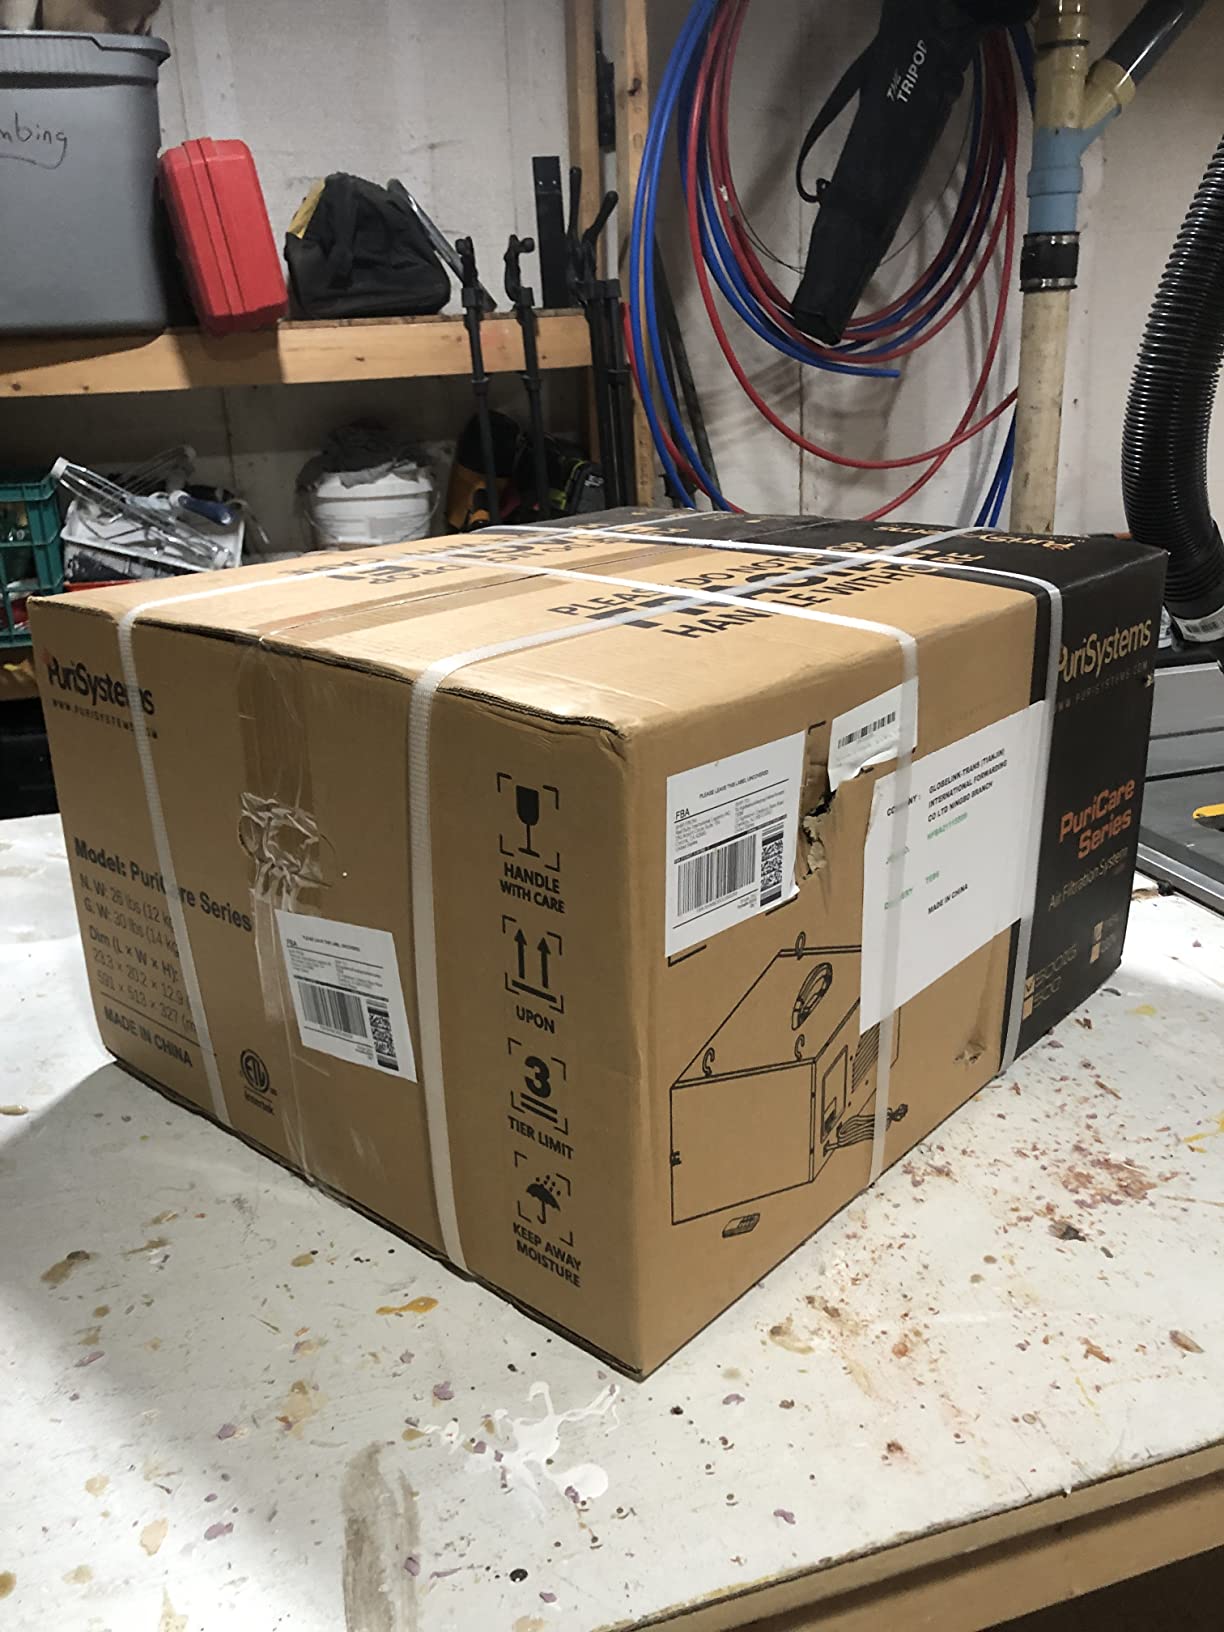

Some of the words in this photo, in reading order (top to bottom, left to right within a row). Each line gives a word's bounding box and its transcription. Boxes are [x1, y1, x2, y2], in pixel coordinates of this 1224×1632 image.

[547, 585, 682, 616] PLEAS
[675, 571, 736, 586] DO
[727, 556, 796, 575] NOT
[793, 541, 868, 561] DOP
[812, 567, 914, 597] WITH
[899, 551, 985, 575] CRE
[928, 780, 973, 808] INTERNATIONAL
[973, 759, 1008, 782] FORWARDING
[970, 780, 994, 799] BRANCH
[675, 807, 690, 820] FBA
[1058, 778, 1136, 844] PuriCare
[1077, 808, 1132, 860] Series
[74, 836, 127, 877] Model:
[130, 860, 196, 908] Purire
[200, 891, 252, 933] Series
[500, 878, 531, 902] WITH
[533, 891, 565, 914] CARE
[503, 862, 560, 894] HANDLE
[104, 1006, 138, 1037] MADE
[154, 1034, 192, 1068] CHINA
[515, 1004, 555, 1034] UPON
[524, 1055, 551, 1099] 3
[507, 1114, 536, 1141] TIER
[538, 1131, 574, 1160] LIMIT
[513, 1221, 542, 1247] KEEP
[544, 1241, 582, 1272] AWAY
[516, 1240, 582, 1288] MOISTURE
